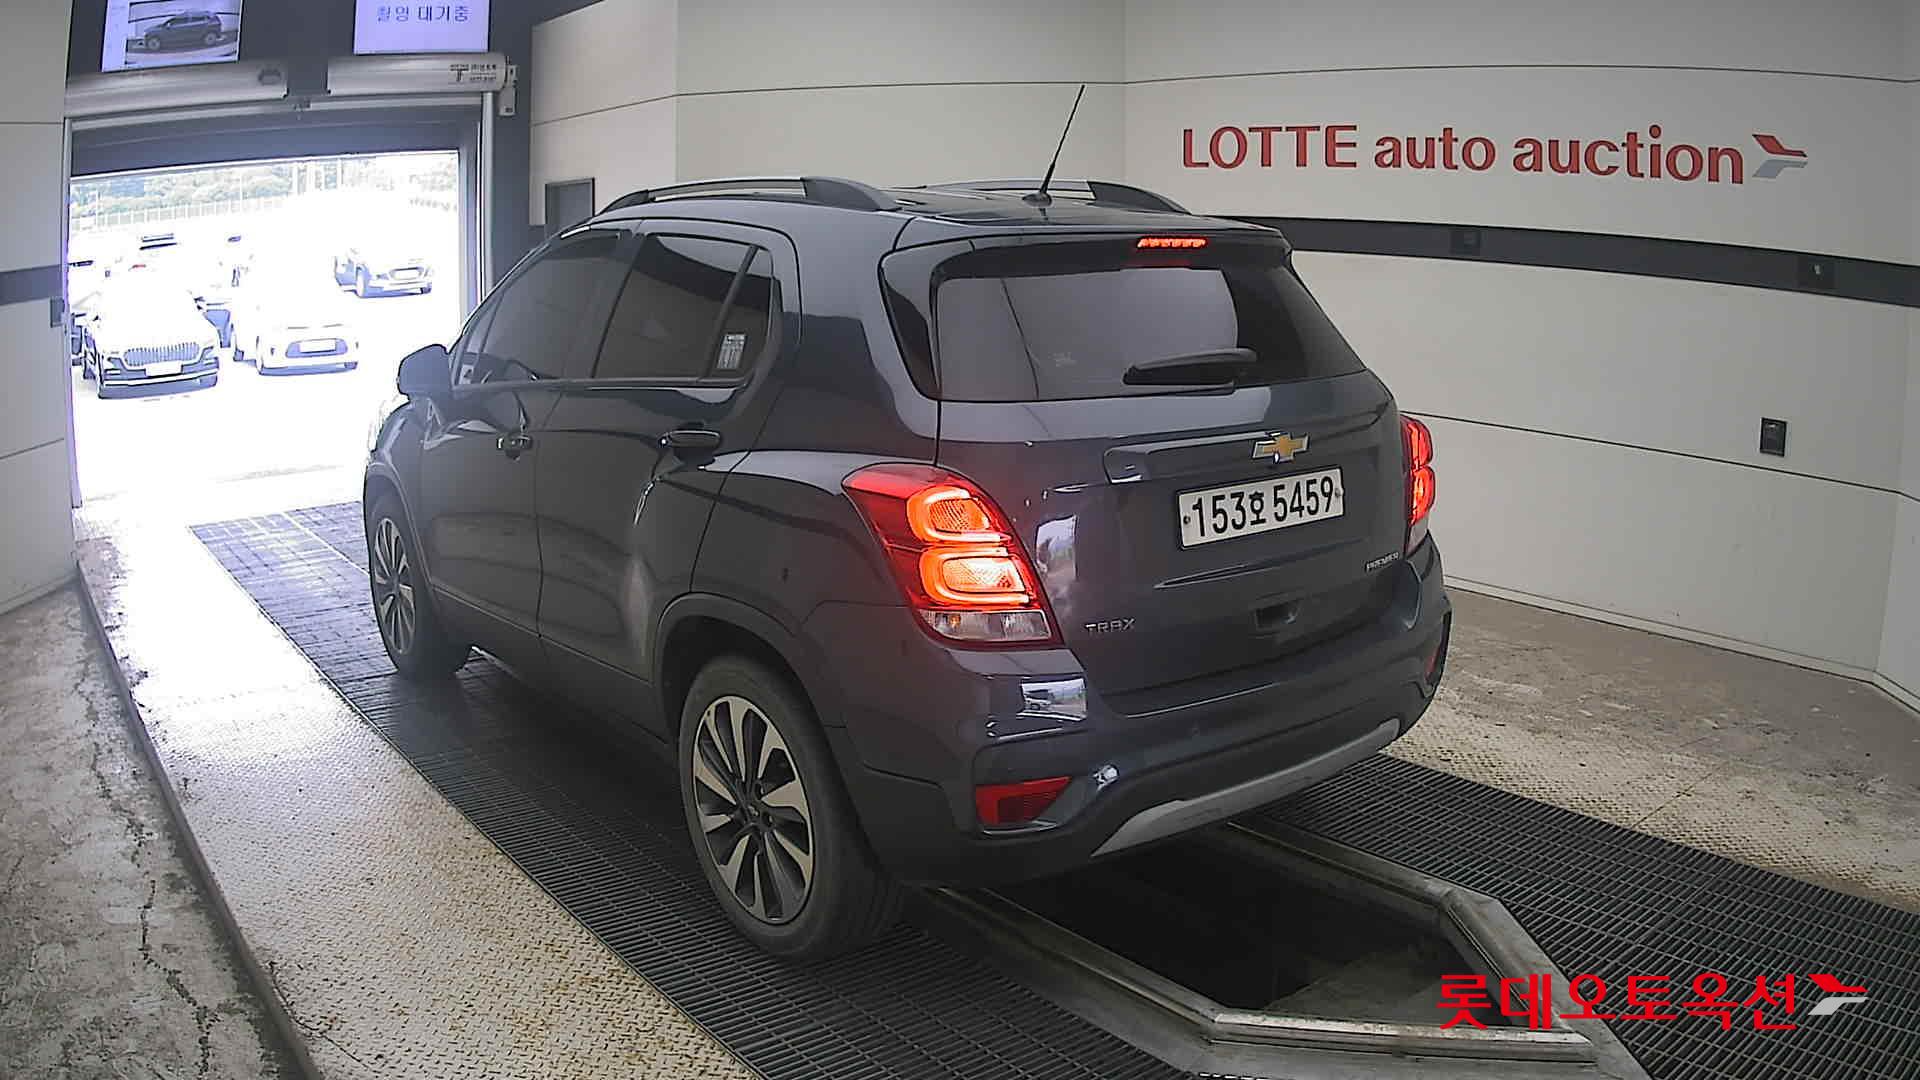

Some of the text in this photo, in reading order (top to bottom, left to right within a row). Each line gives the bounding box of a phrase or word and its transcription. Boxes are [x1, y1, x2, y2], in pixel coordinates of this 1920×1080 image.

[418, 5, 468, 22] 대기중
[1183, 124, 1744, 185] LOTTE auto auction
[1191, 475, 1334, 537] 153호 5459
[1085, 617, 1135, 634] TRAX
